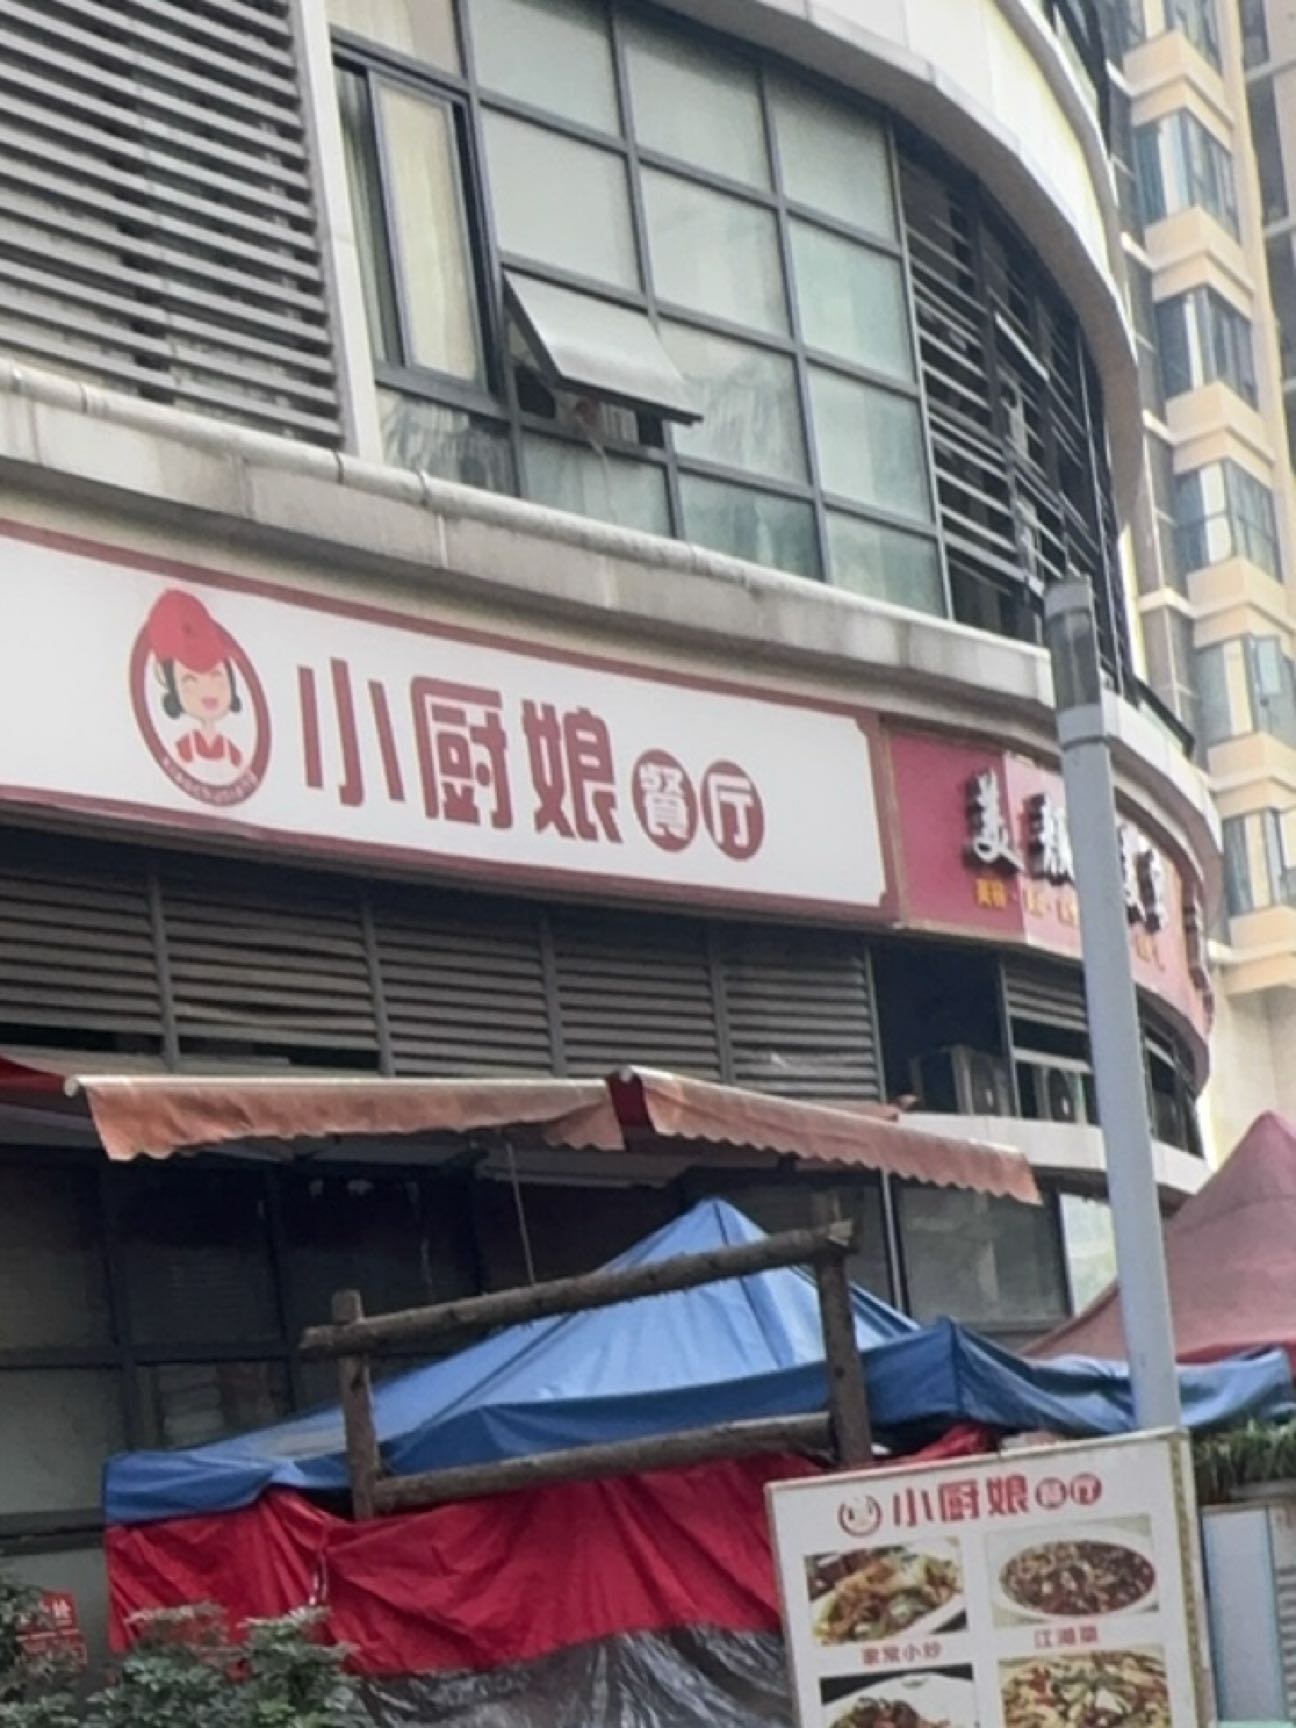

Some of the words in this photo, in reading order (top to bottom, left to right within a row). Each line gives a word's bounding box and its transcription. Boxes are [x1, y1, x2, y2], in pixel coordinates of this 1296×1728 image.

[297, 657, 622, 844] 小厨娘
[633, 750, 765, 860] 餐厅
[893, 1474, 1030, 1527] 小厨娘
